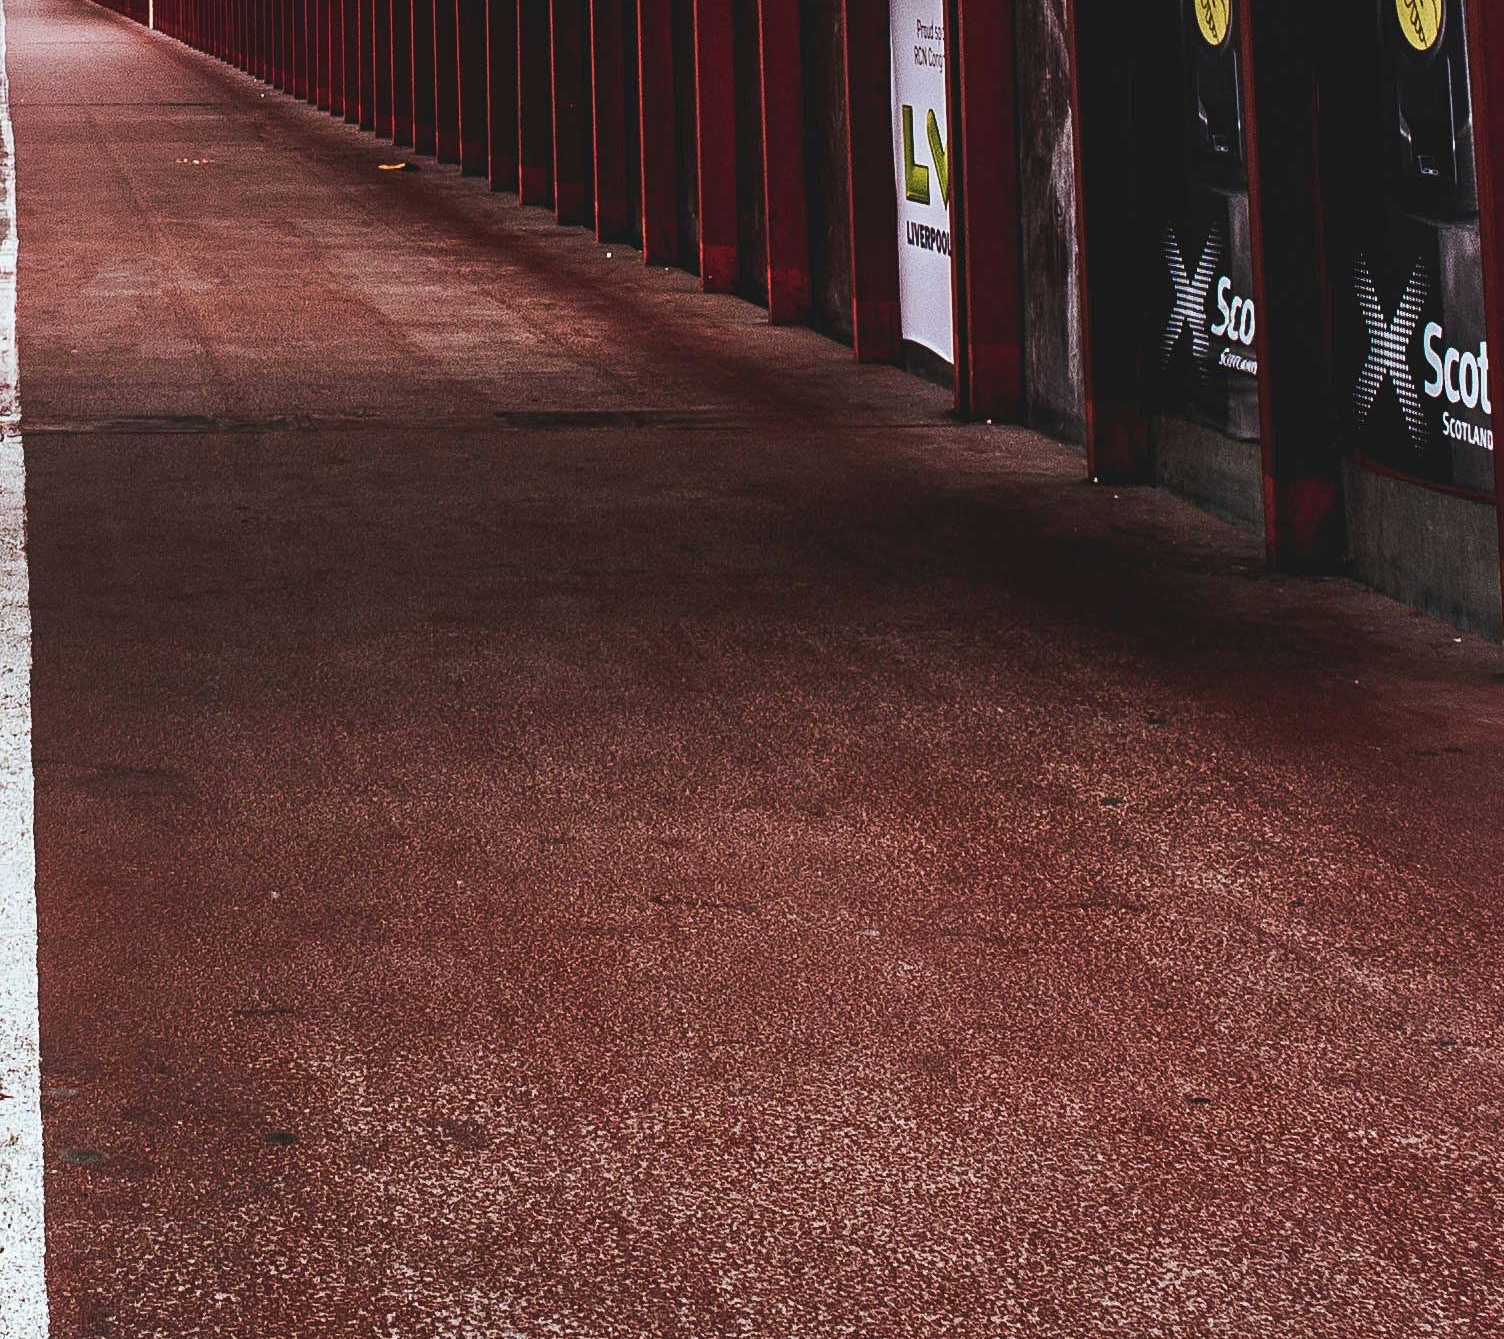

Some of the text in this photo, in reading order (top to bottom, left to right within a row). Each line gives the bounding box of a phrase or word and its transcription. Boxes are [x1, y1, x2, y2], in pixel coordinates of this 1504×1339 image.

[906, 220, 952, 257] LIVERPOOL
[1423, 321, 1492, 415] Scot
[1442, 411, 1494, 451] SCOTLAND
